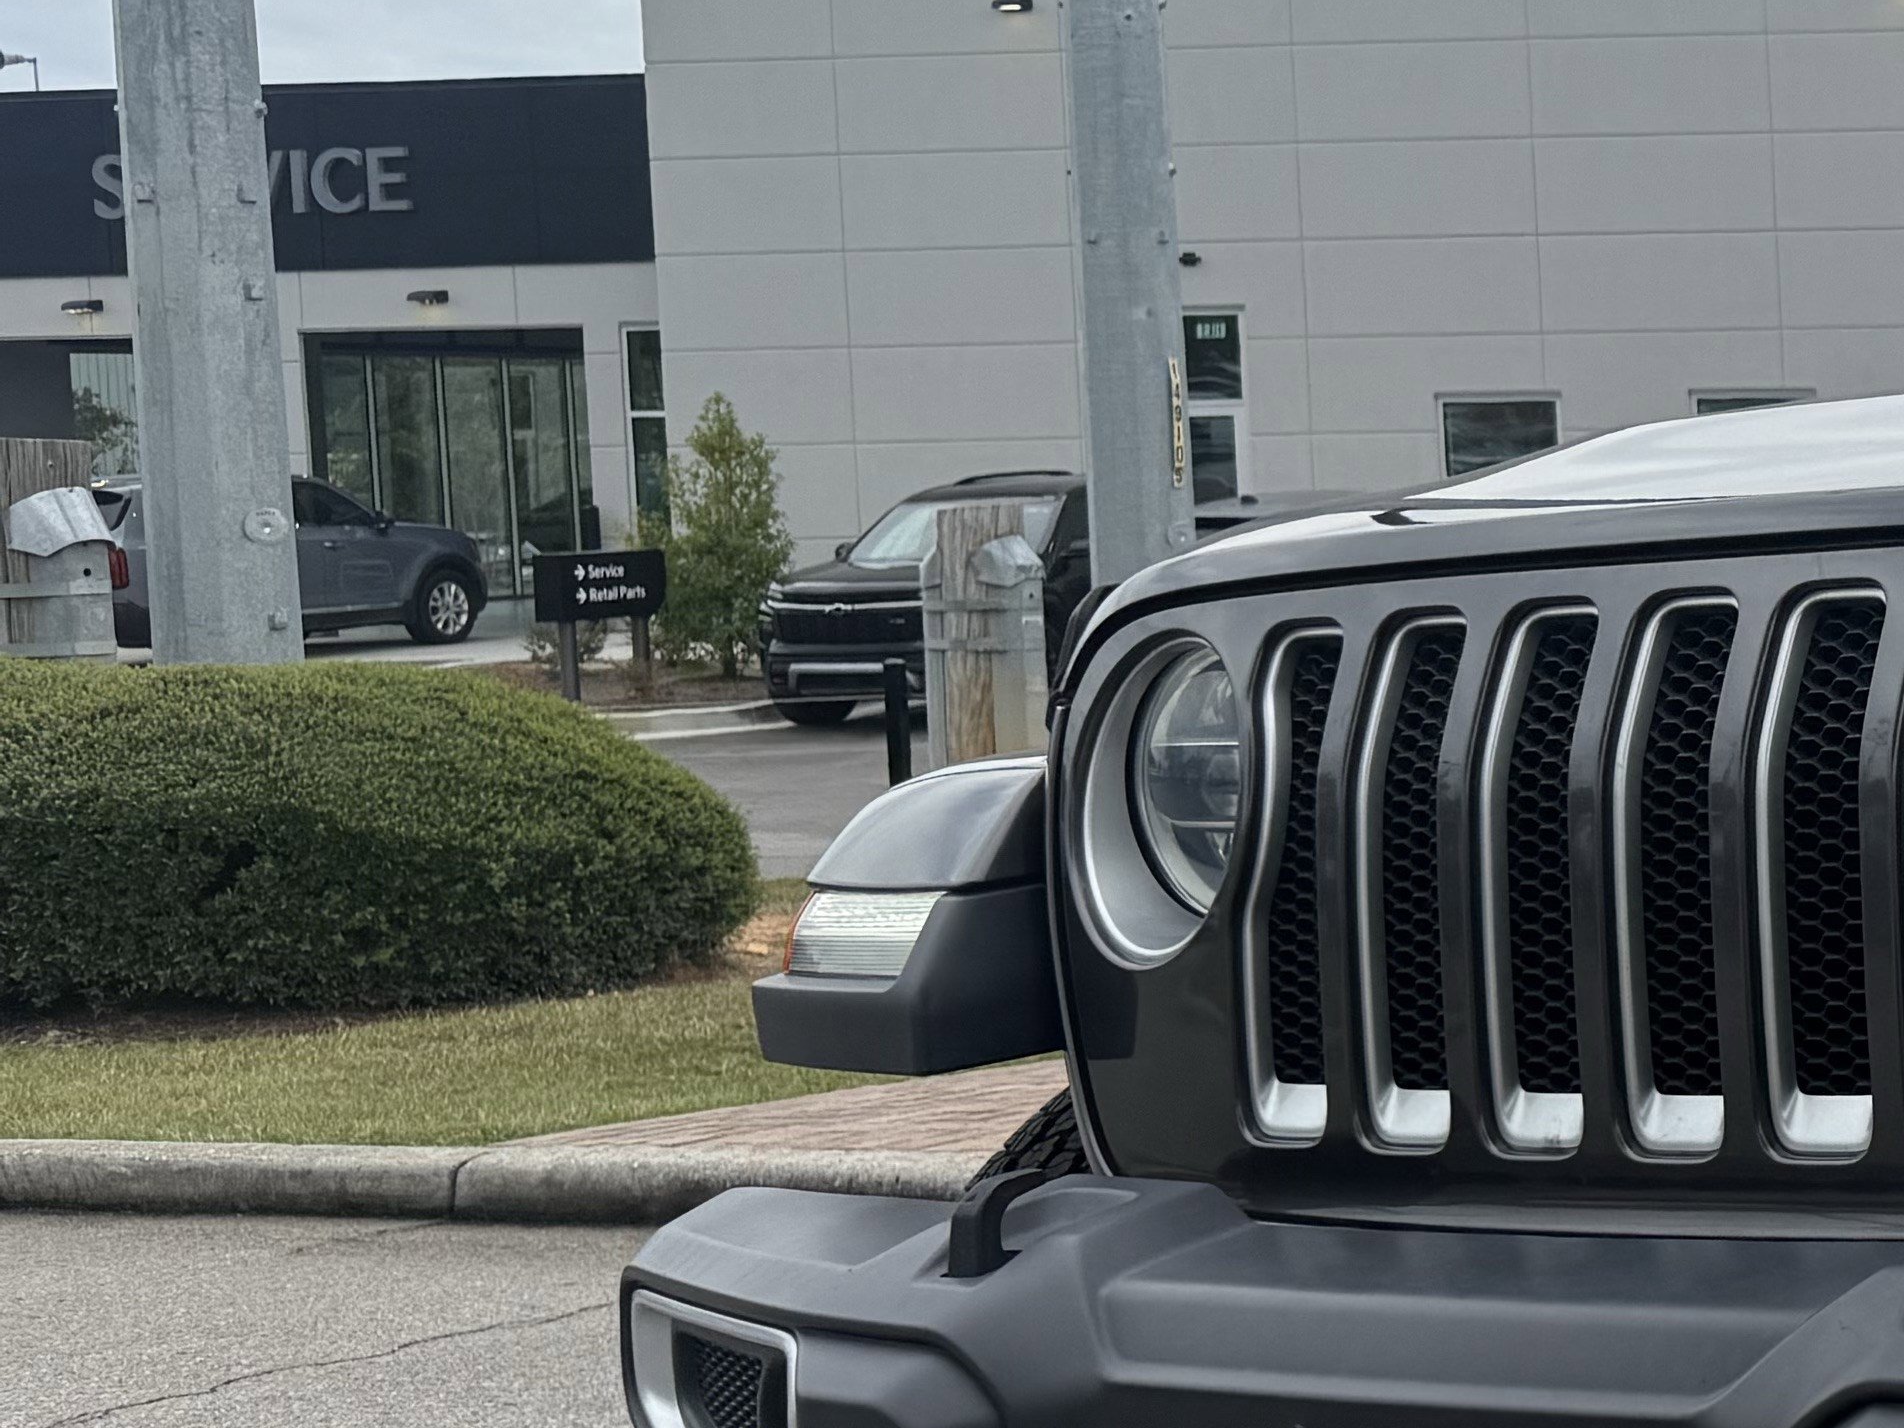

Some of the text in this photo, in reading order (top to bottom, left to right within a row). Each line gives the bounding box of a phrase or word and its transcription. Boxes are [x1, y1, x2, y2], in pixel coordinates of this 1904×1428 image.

[588, 564, 624, 579] Service
[589, 585, 646, 602] Retail Parts
